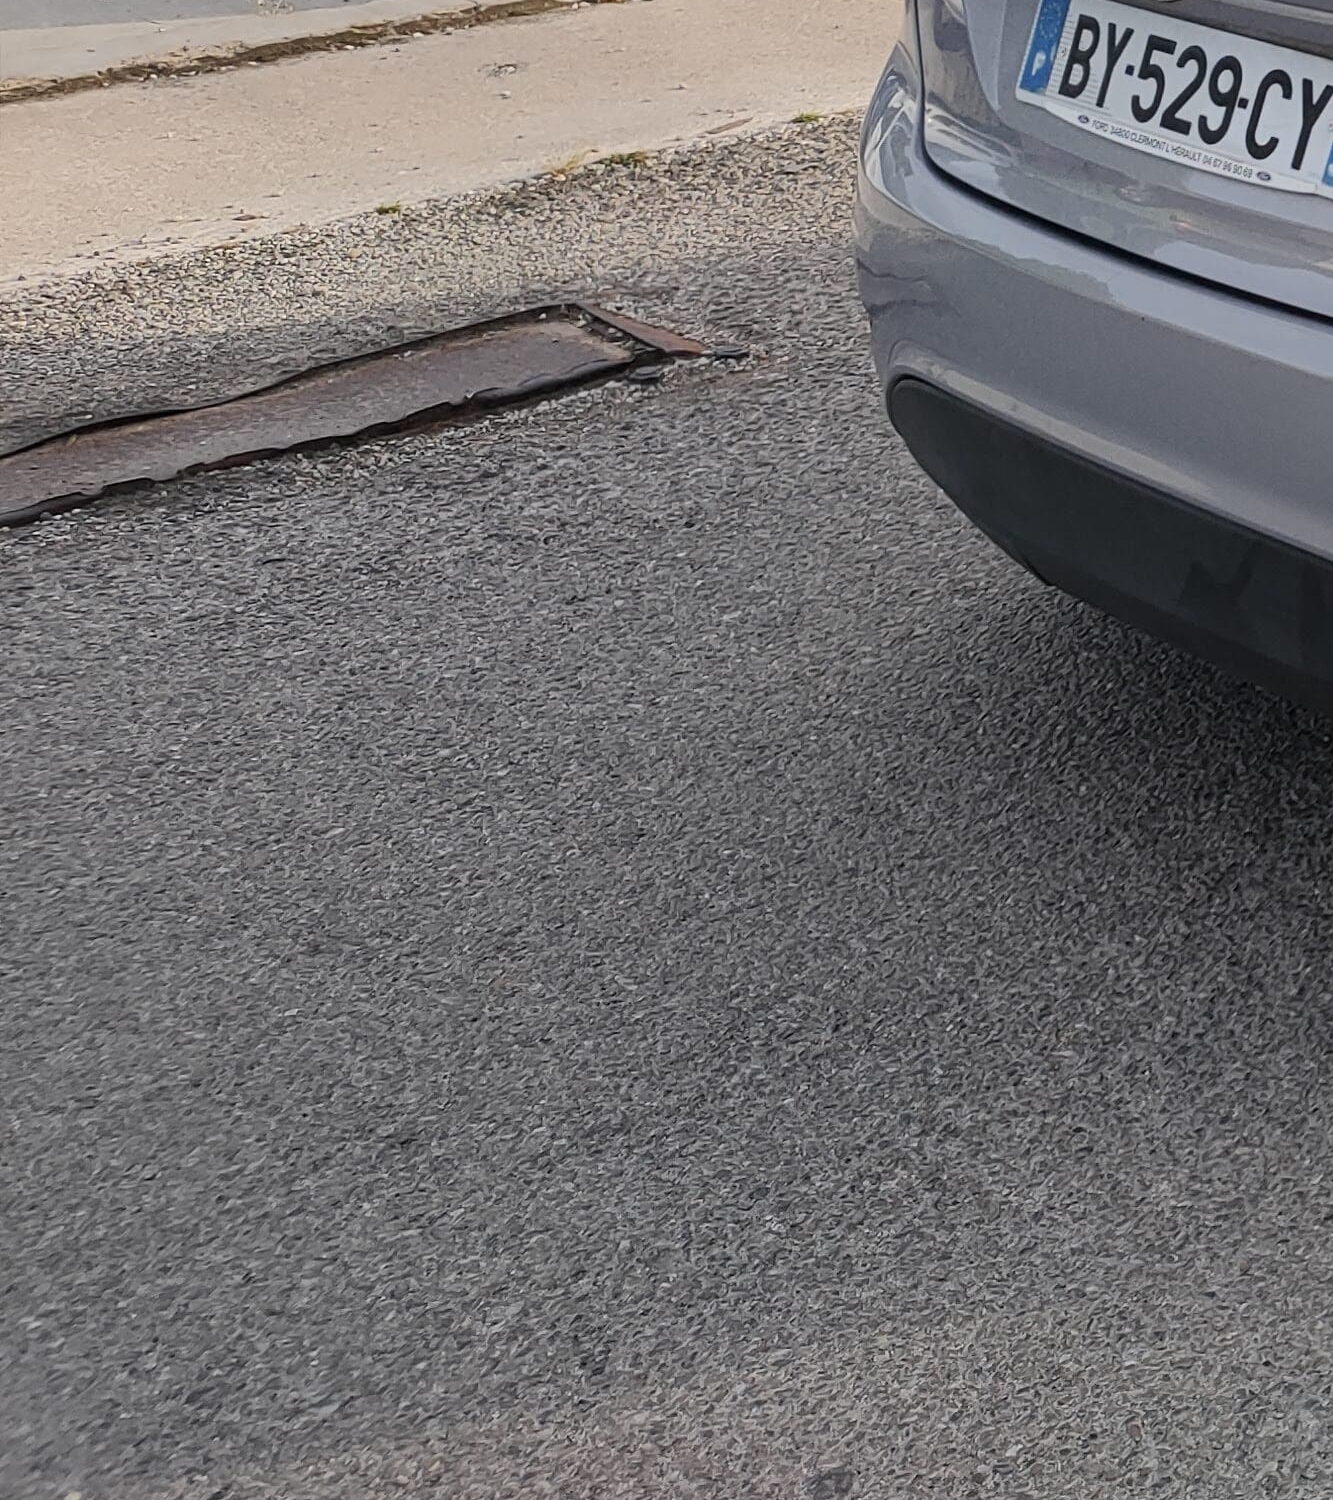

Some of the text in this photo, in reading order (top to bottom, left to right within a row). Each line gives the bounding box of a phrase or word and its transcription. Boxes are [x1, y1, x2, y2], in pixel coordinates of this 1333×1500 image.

[1130, 131, 1167, 152] CLERMONT
[1202, 154, 1213, 166] 04
[1213, 158, 1223, 169] 67
[1232, 164, 1244, 176] 90
[1243, 167, 1254, 179] 69
